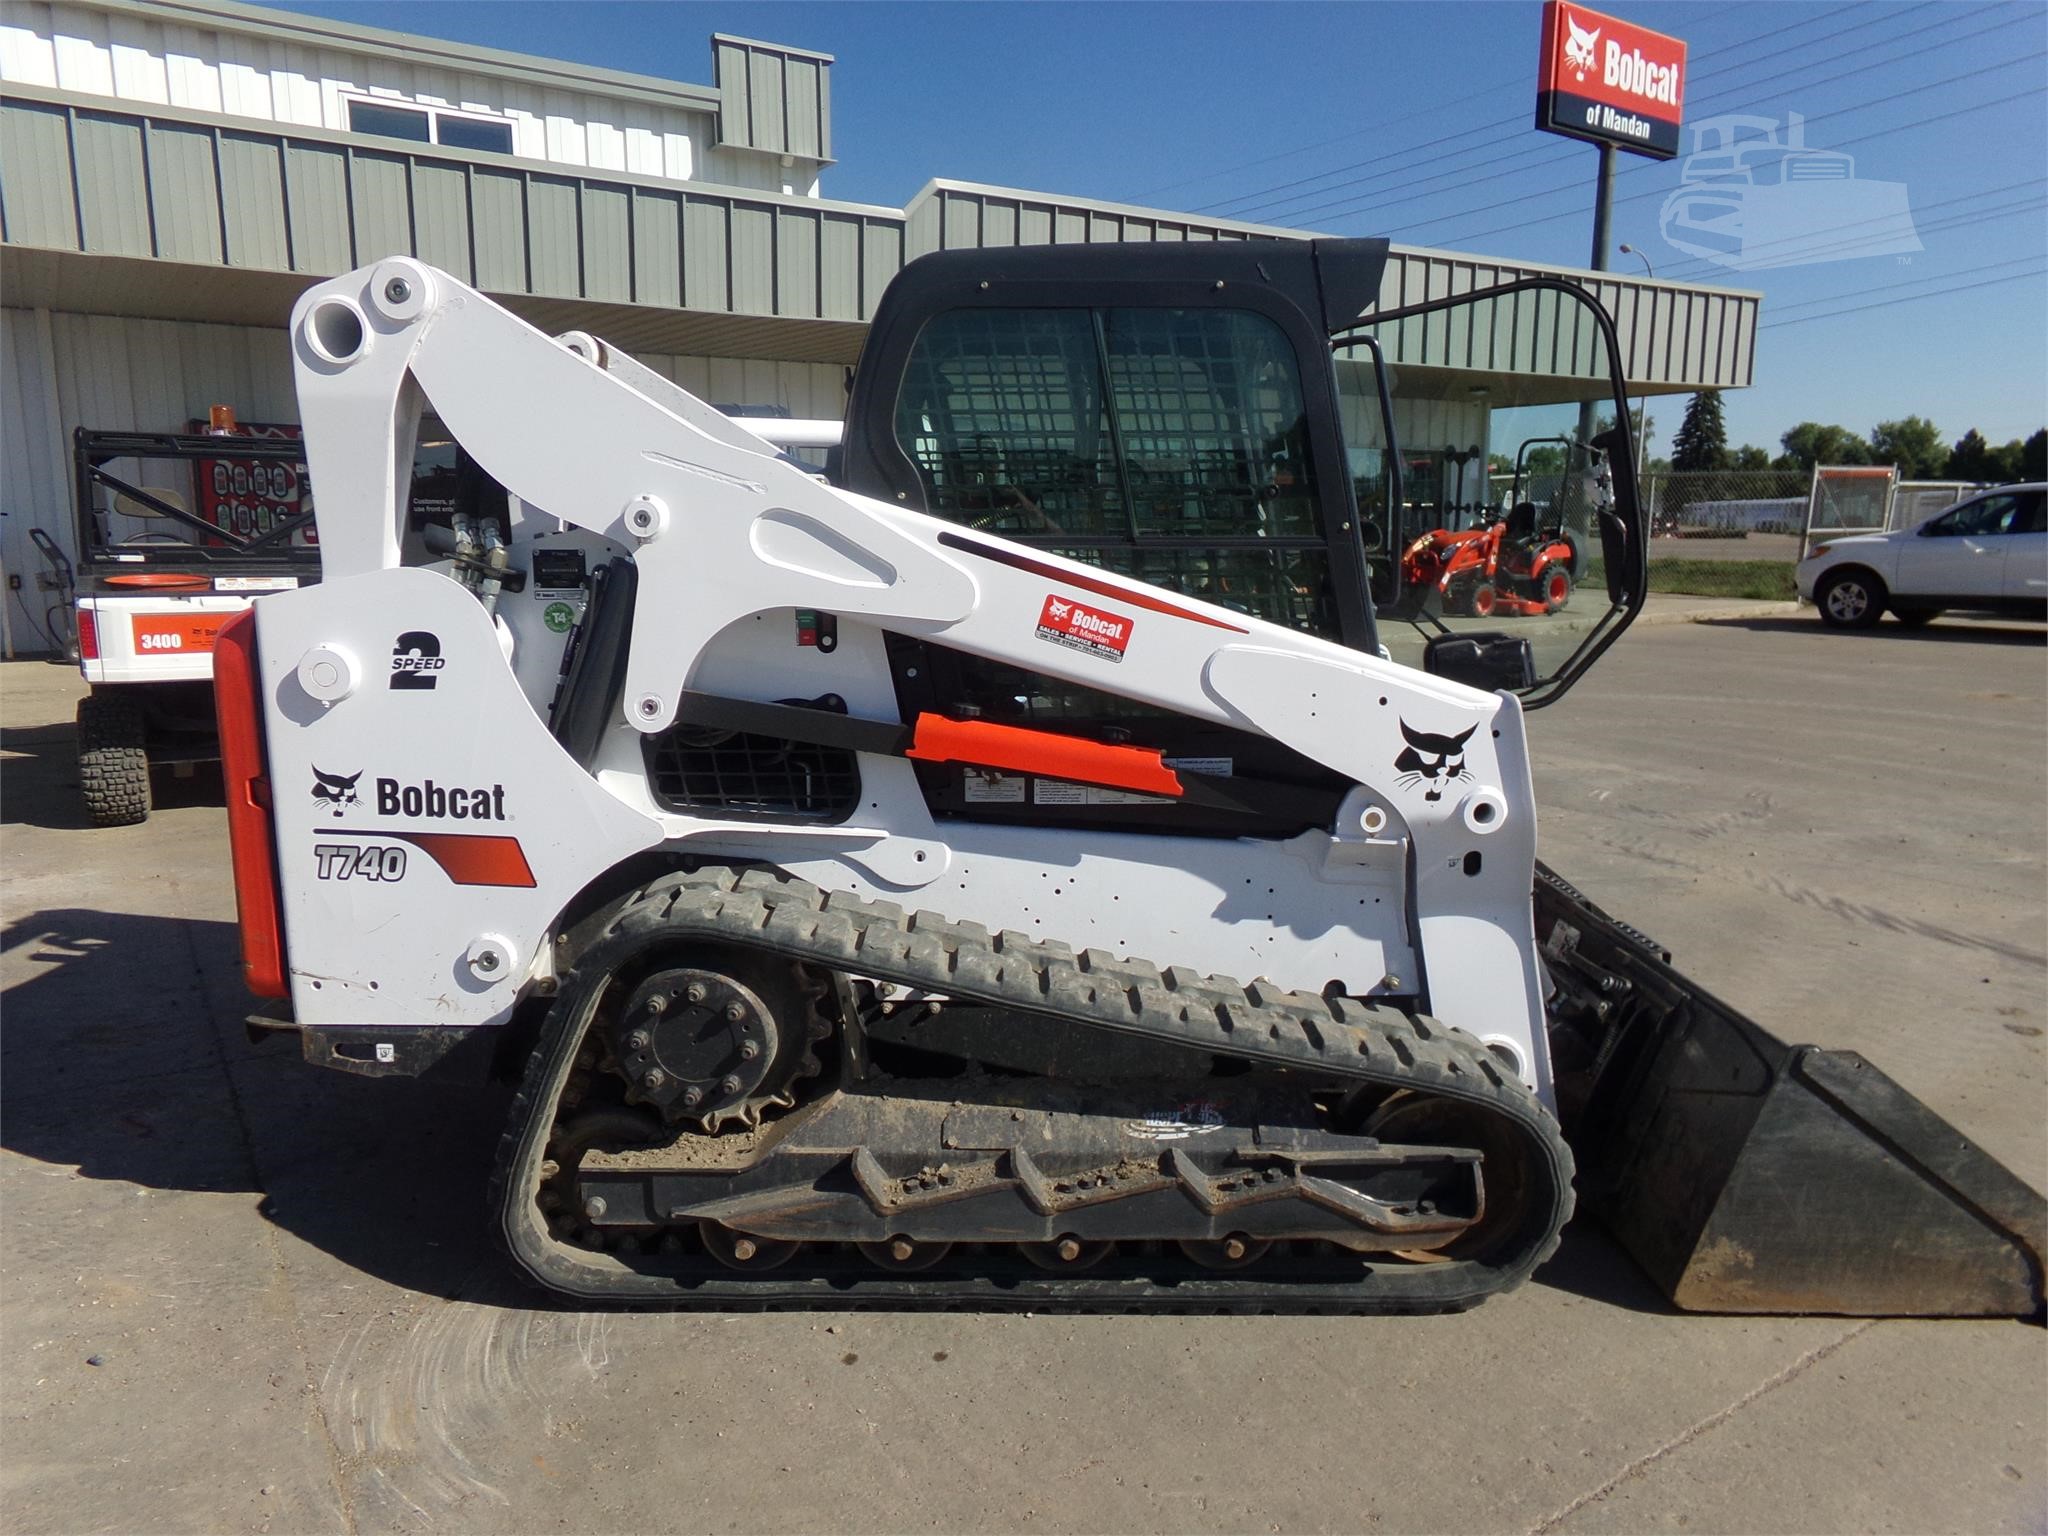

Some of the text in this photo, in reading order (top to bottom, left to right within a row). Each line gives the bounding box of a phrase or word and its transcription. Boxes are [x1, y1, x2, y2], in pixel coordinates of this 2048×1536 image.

[1604, 39, 1679, 106] Bobcat
[1586, 104, 1650, 139] of Mandan
[552, 612, 567, 624] T4
[1071, 610, 1122, 639] Bobcat
[140, 633, 182, 649] 3400
[1039, 625, 1121, 655] SALES SERVICE RENTAL
[1069, 626, 1109, 644] of Mandan
[389, 631, 441, 690] 2
[391, 658, 446, 670] SPEED
[376, 777, 506, 821] Bobcat
[314, 844, 407, 882] T740
